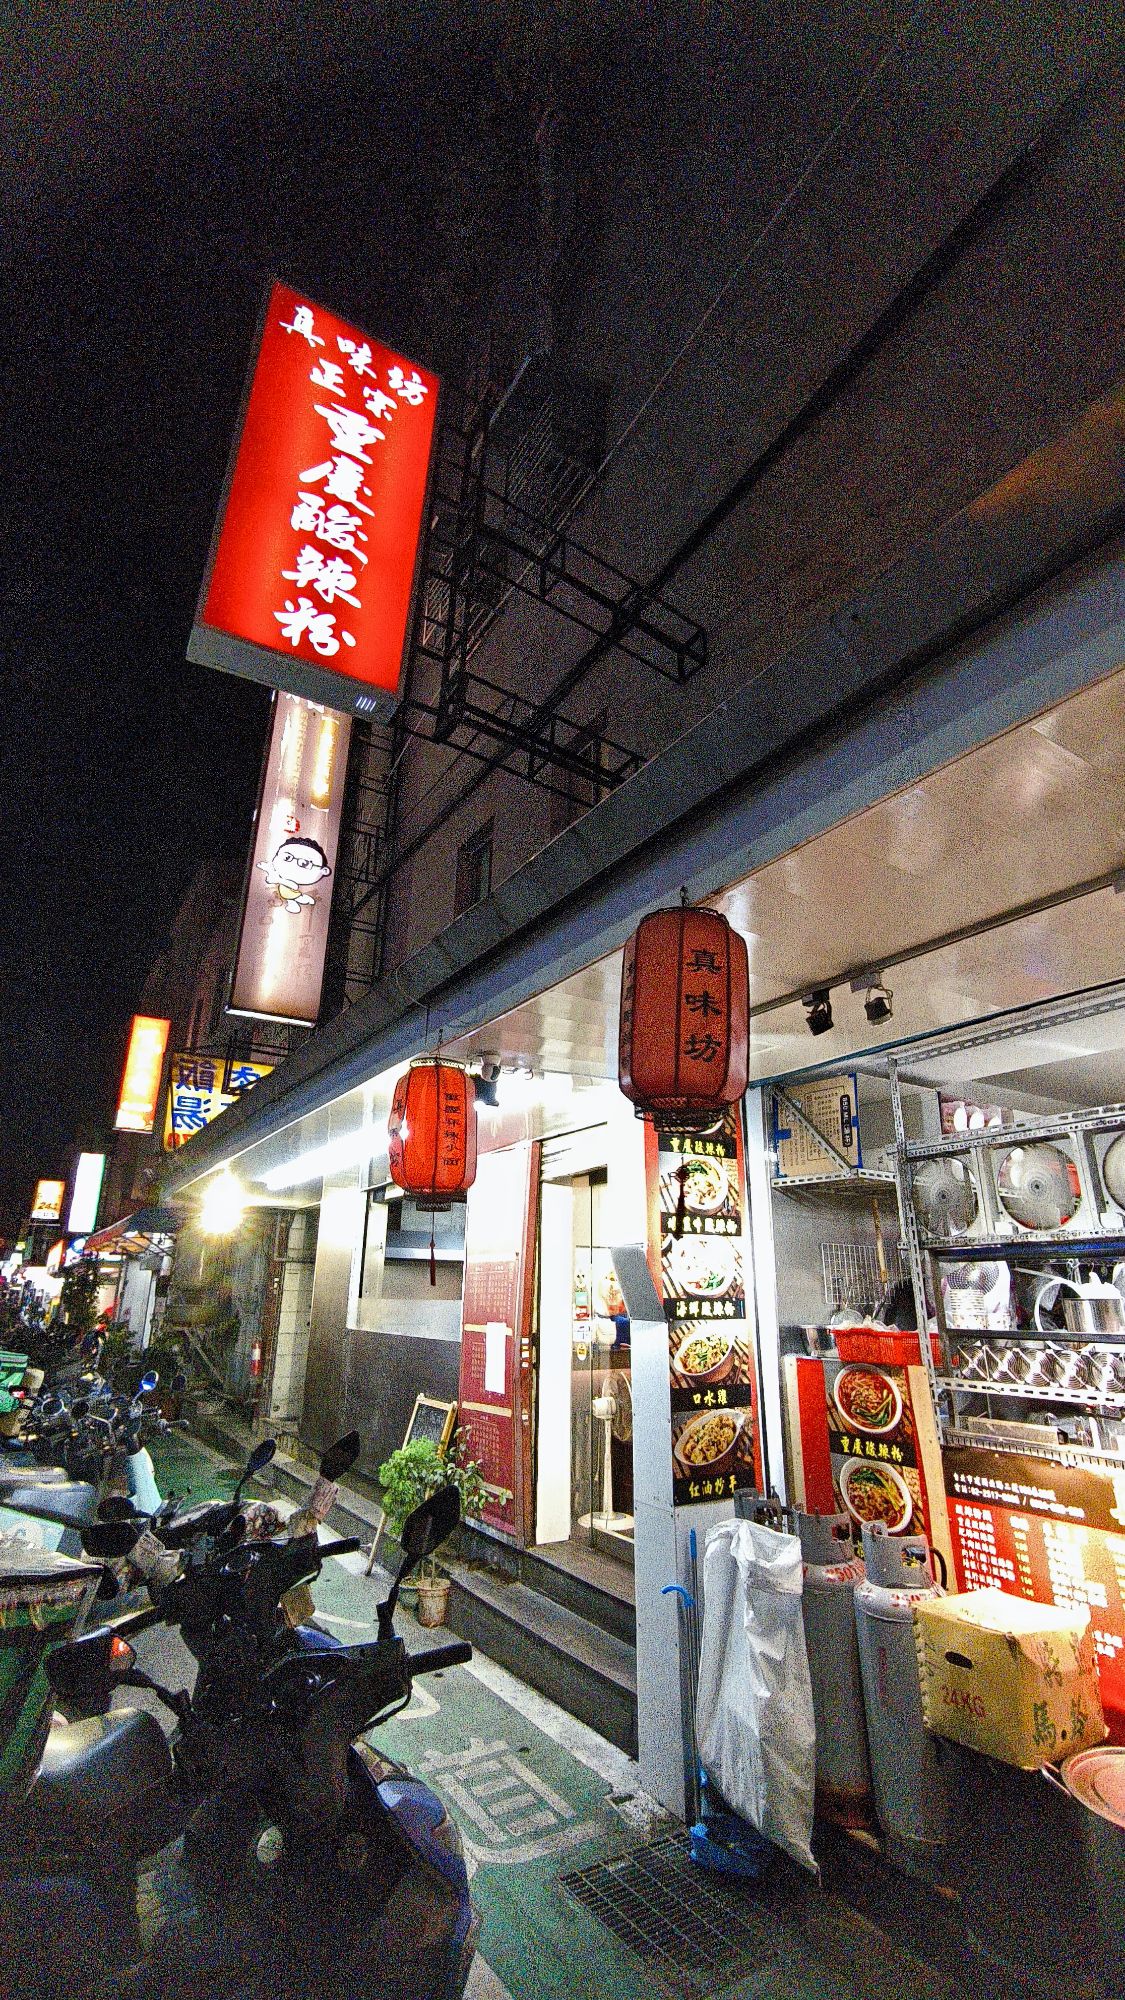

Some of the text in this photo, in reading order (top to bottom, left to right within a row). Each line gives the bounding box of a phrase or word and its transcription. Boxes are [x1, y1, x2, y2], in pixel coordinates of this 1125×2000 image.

[279, 305, 429, 406] 真味坊
[309, 358, 399, 422] 正宗
[273, 403, 386, 657] 重慶酸辣粉
[685, 949, 722, 1063] 真味坊
[669, 1136, 726, 1157] 重慶酸辣粉
[692, 1389, 728, 1406] 口水雞
[840, 1436, 904, 1462] 重慶酸辣粉
